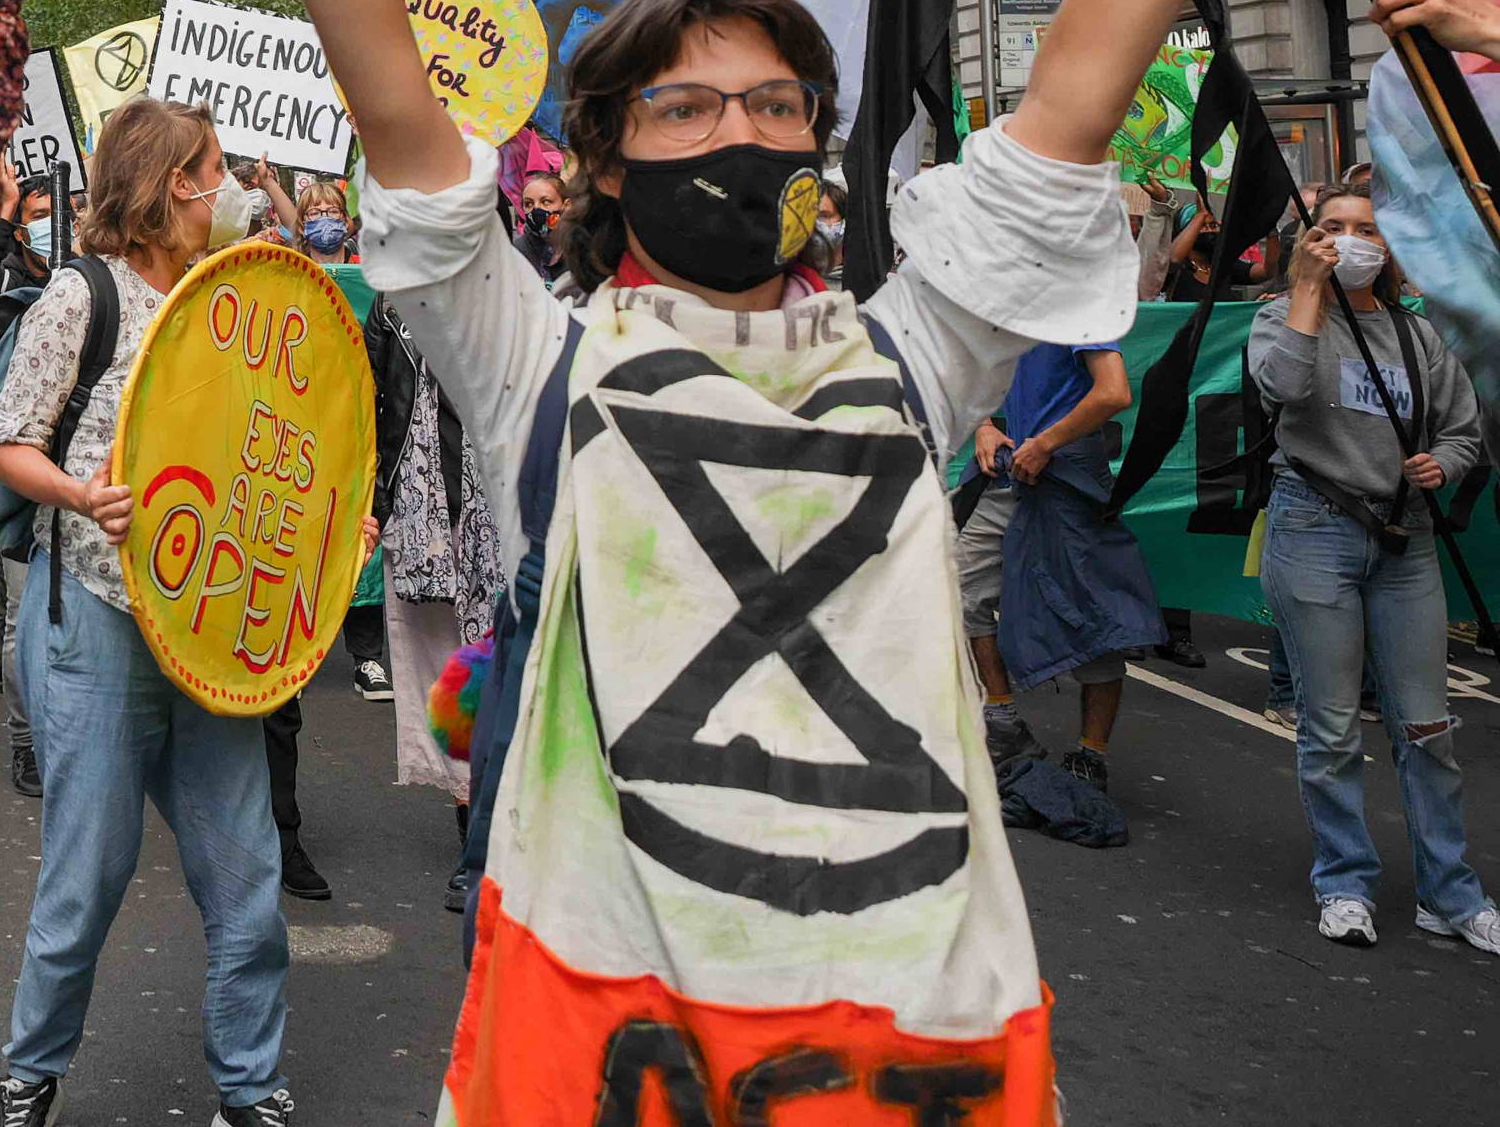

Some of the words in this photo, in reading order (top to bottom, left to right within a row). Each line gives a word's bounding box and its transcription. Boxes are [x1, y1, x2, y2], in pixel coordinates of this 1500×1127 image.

[164, 74, 348, 150] EMERGENCY
[426, 54, 470, 97] FOR
[207, 283, 309, 396] OUR
[241, 399, 315, 493] EYES
[219, 471, 305, 558] ARE
[147, 485, 338, 675] OPEN
